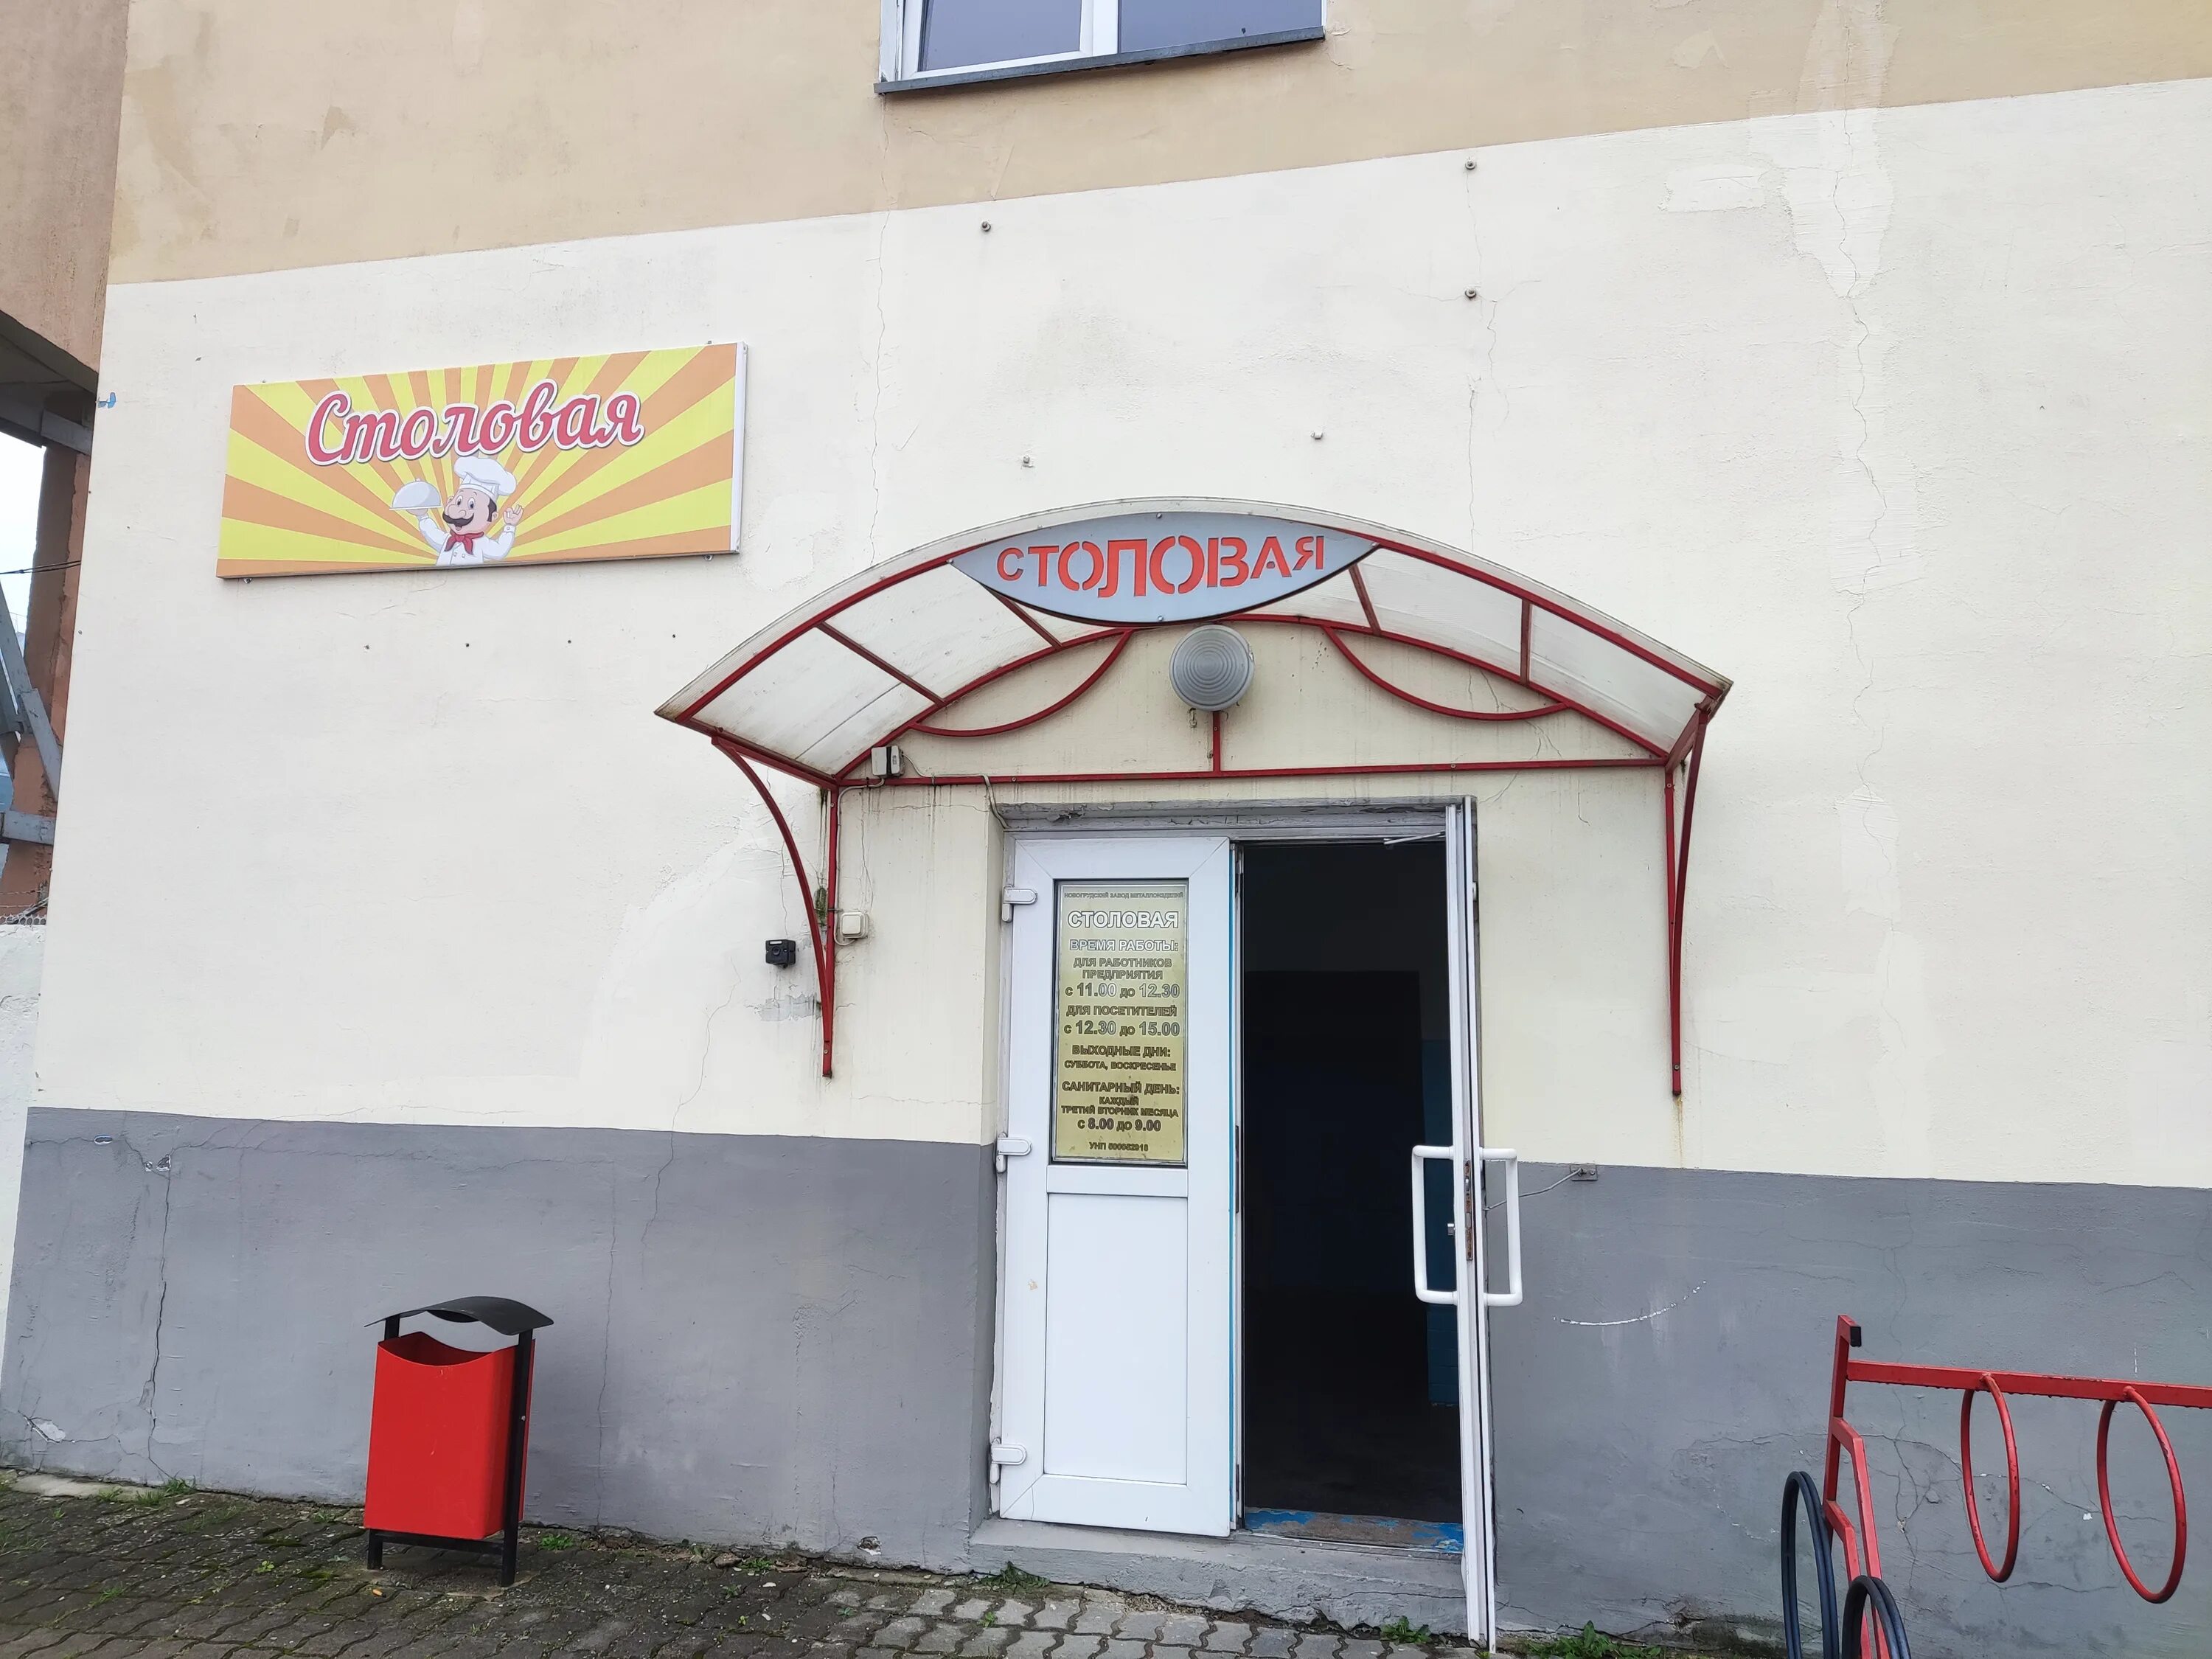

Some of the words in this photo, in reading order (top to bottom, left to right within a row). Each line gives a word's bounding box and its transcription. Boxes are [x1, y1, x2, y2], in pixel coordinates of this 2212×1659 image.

[305, 378, 646, 466] Столовая
[996, 535, 1325, 598] СТОЛОВАЯ
[1068, 911, 1179, 928] СТОЛОВАЯ
[1069, 939, 1116, 950] ВРЕМЯ
[1119, 939, 1179, 951] РАБОТЫ:
[1073, 958, 1096, 968] ДЛЯ
[1099, 958, 1172, 968] РАБОТНИКОВ
[1082, 970, 1164, 981] ПРЕДПРИЯТИЯ
[1077, 982, 1117, 997] 11.00
[1138, 983, 1180, 998] 12.30
[1066, 1005, 1091, 1016] ДЛЯ
[1093, 1005, 1178, 1017] ПОСЕТИТЕЛЕЙ
[1075, 1020, 1117, 1034] 12.30
[1138, 1021, 1180, 1036] 15.00
[1072, 1045, 1141, 1057] ВЫХОДНЫЕ
[1143, 1046, 1171, 1058] ДНИ:
[1064, 1060, 1108, 1071] СУББОТА,
[1110, 1061, 1177, 1071] ВОСКРЕСЕНЬЕ
[1062, 1081, 1141, 1093] САНИТАРНЫЙ
[1144, 1083, 1180, 1095] ДЕНЬ:
[1099, 1096, 1139, 1106] КАЖДЫЙ
[1060, 1105, 1096, 1114] ТРЕТИЙ
[1097, 1107, 1139, 1116] ВТОРНИК
[1140, 1108, 1179, 1118] МЕСЯЦА
[1088, 1117, 1114, 1130] 8.00
[1134, 1119, 1161, 1132] 9.00
[1088, 1141, 1107, 1150] УНП
